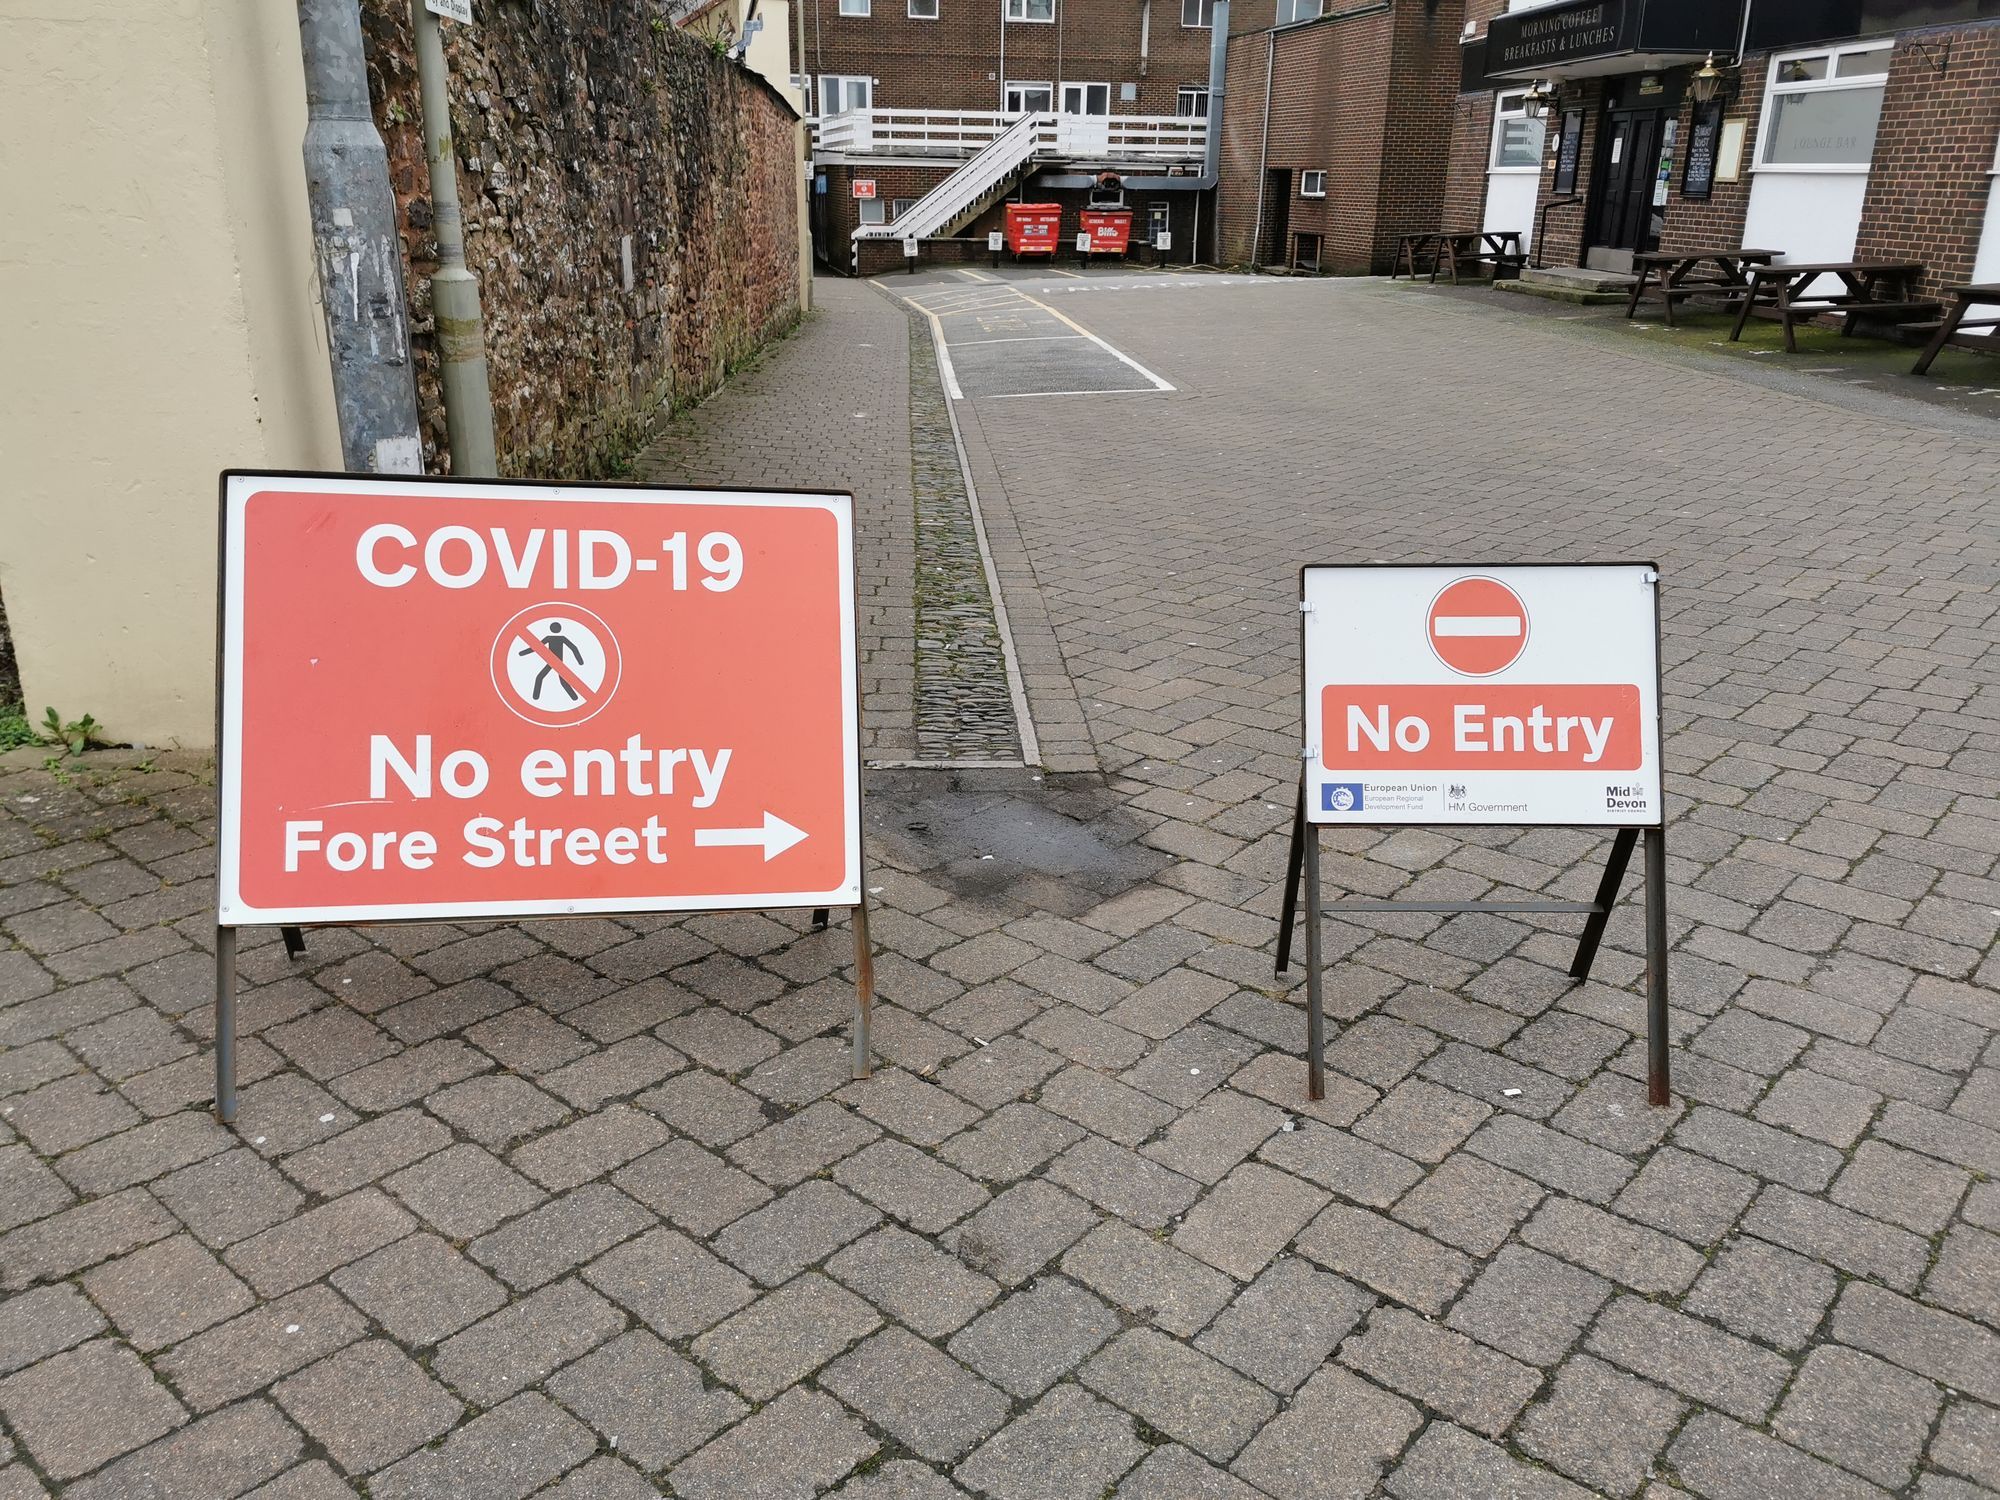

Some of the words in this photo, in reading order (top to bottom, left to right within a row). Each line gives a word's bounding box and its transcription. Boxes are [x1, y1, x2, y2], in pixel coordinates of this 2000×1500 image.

[1521, 17, 1561, 39] MORNING
[1562, 6, 1599, 30] COFFEE
[1504, 38, 1556, 62] BREAKFASTS
[1559, 36, 1567, 52] &
[1570, 26, 1615, 49] LUNCHES
[355, 522, 745, 594] COVID-19
[1347, 704, 1431, 752] No
[1453, 704, 1615, 763] Entry
[369, 733, 489, 799] No
[520, 732, 733, 809] entry
[1364, 783, 1408, 793] European
[1410, 783, 1438, 792] Union
[1364, 795, 1394, 803] European
[1396, 795, 1424, 803] Regional
[1606, 786, 1630, 797] Mid
[1606, 798, 1647, 809] Devon
[1448, 803, 1466, 812] HM
[1468, 802, 1528, 812] Government
[284, 819, 438, 873] Fore
[461, 814, 668, 869] Street
